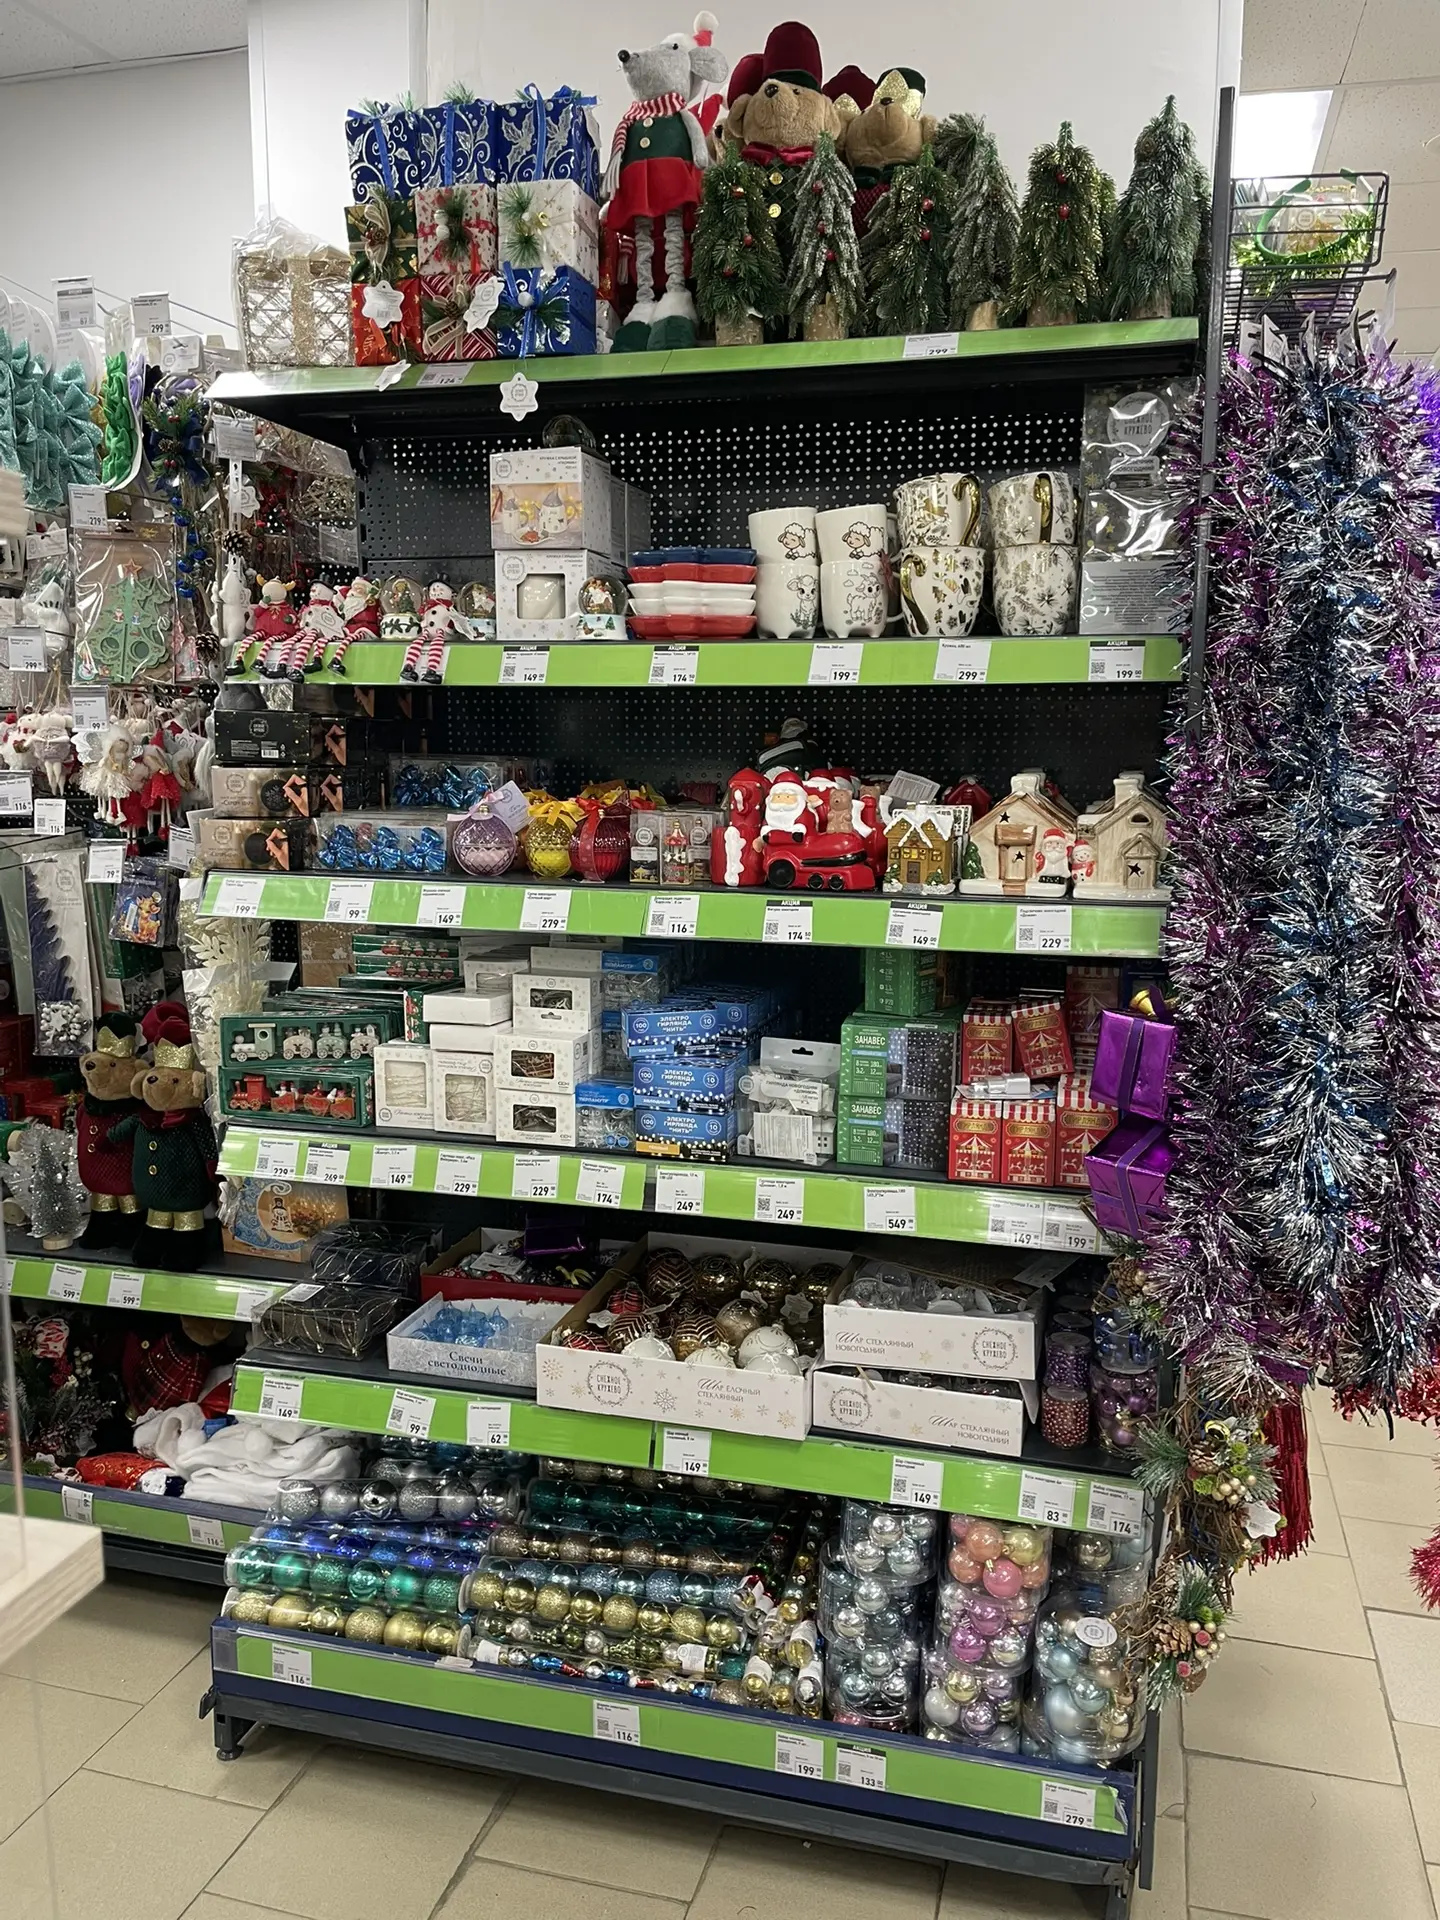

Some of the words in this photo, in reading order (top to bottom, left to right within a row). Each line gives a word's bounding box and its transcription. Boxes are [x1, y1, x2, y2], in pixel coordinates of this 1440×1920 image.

[152, 324, 164, 333] 299
[25, 662, 37, 670] 299
[673, 674, 687, 682] 174
[832, 672, 850, 681] 199
[958, 671, 978, 680] 299
[1116, 670, 1133, 678] 199
[92, 722, 100, 730] 99
[15, 802, 27, 810] 116
[106, 870, 115, 878] 79
[234, 906, 250, 914] 199
[348, 910, 360, 918] 99
[438, 914, 454, 924] 149
[542, 919, 559, 929] 279
[671, 924, 687, 934] 116
[788, 932, 803, 941] 174
[912, 936, 928, 945] 149
[1041, 938, 1062, 948] 229
[854, 1035, 886, 1046] ЗАНАВЕС
[661, 1074, 696, 1082] ГИРЛЯНДА
[851, 1104, 882, 1115] ЗАНАВЕС
[664, 1121, 698, 1129] ГИРЛЯНДА
[391, 1174, 406, 1184] 149
[454, 1183, 470, 1193] 229
[533, 1186, 549, 1196] 229
[596, 1193, 613, 1204] 174
[677, 1202, 694, 1211] 249
[777, 1209, 795, 1220] 249
[888, 1219, 907, 1229] 549
[1014, 1233, 1032, 1244] 149
[1068, 1236, 1087, 1248] 199
[64, 1289, 76, 1298] 599
[123, 1296, 135, 1305] 599
[866, 1337, 914, 1349] СТЕКЛЯННЫЙ
[982, 1340, 1007, 1349] СНЕЖНОЕ
[835, 1344, 886, 1354] НОВОГОДНИЙ
[449, 1351, 484, 1365] Свечи
[982, 1350, 1008, 1359] КРУЖЕВО
[428, 1358, 507, 1376] светодиодные
[596, 1374, 621, 1384] СНЕЖНОЕ
[597, 1384, 622, 1394] КРУЖЕВО
[697, 1391, 744, 1402] СТЕКЛЯННЫЙ
[839, 1398, 862, 1409] СНЕЖНОЕ
[278, 1408, 292, 1418] 149
[839, 1407, 862, 1417] КРУЖЕВО
[409, 1424, 420, 1434] 99
[960, 1424, 1010, 1436] СТЕКЛЯННЫЙ
[490, 1434, 502, 1444] 62
[957, 1432, 1010, 1445] НОВОГОДНИЙ
[685, 1462, 700, 1472] 149
[914, 1492, 931, 1504] 149
[1047, 1510, 1059, 1522] 83
[1112, 1521, 1131, 1534] 174
[207, 1537, 220, 1546] 116
[291, 1674, 304, 1684] 116
[617, 1731, 632, 1742] 116
[798, 1764, 815, 1776] 199
[861, 1777, 876, 1787] 133
[1066, 1814, 1085, 1825] 279
